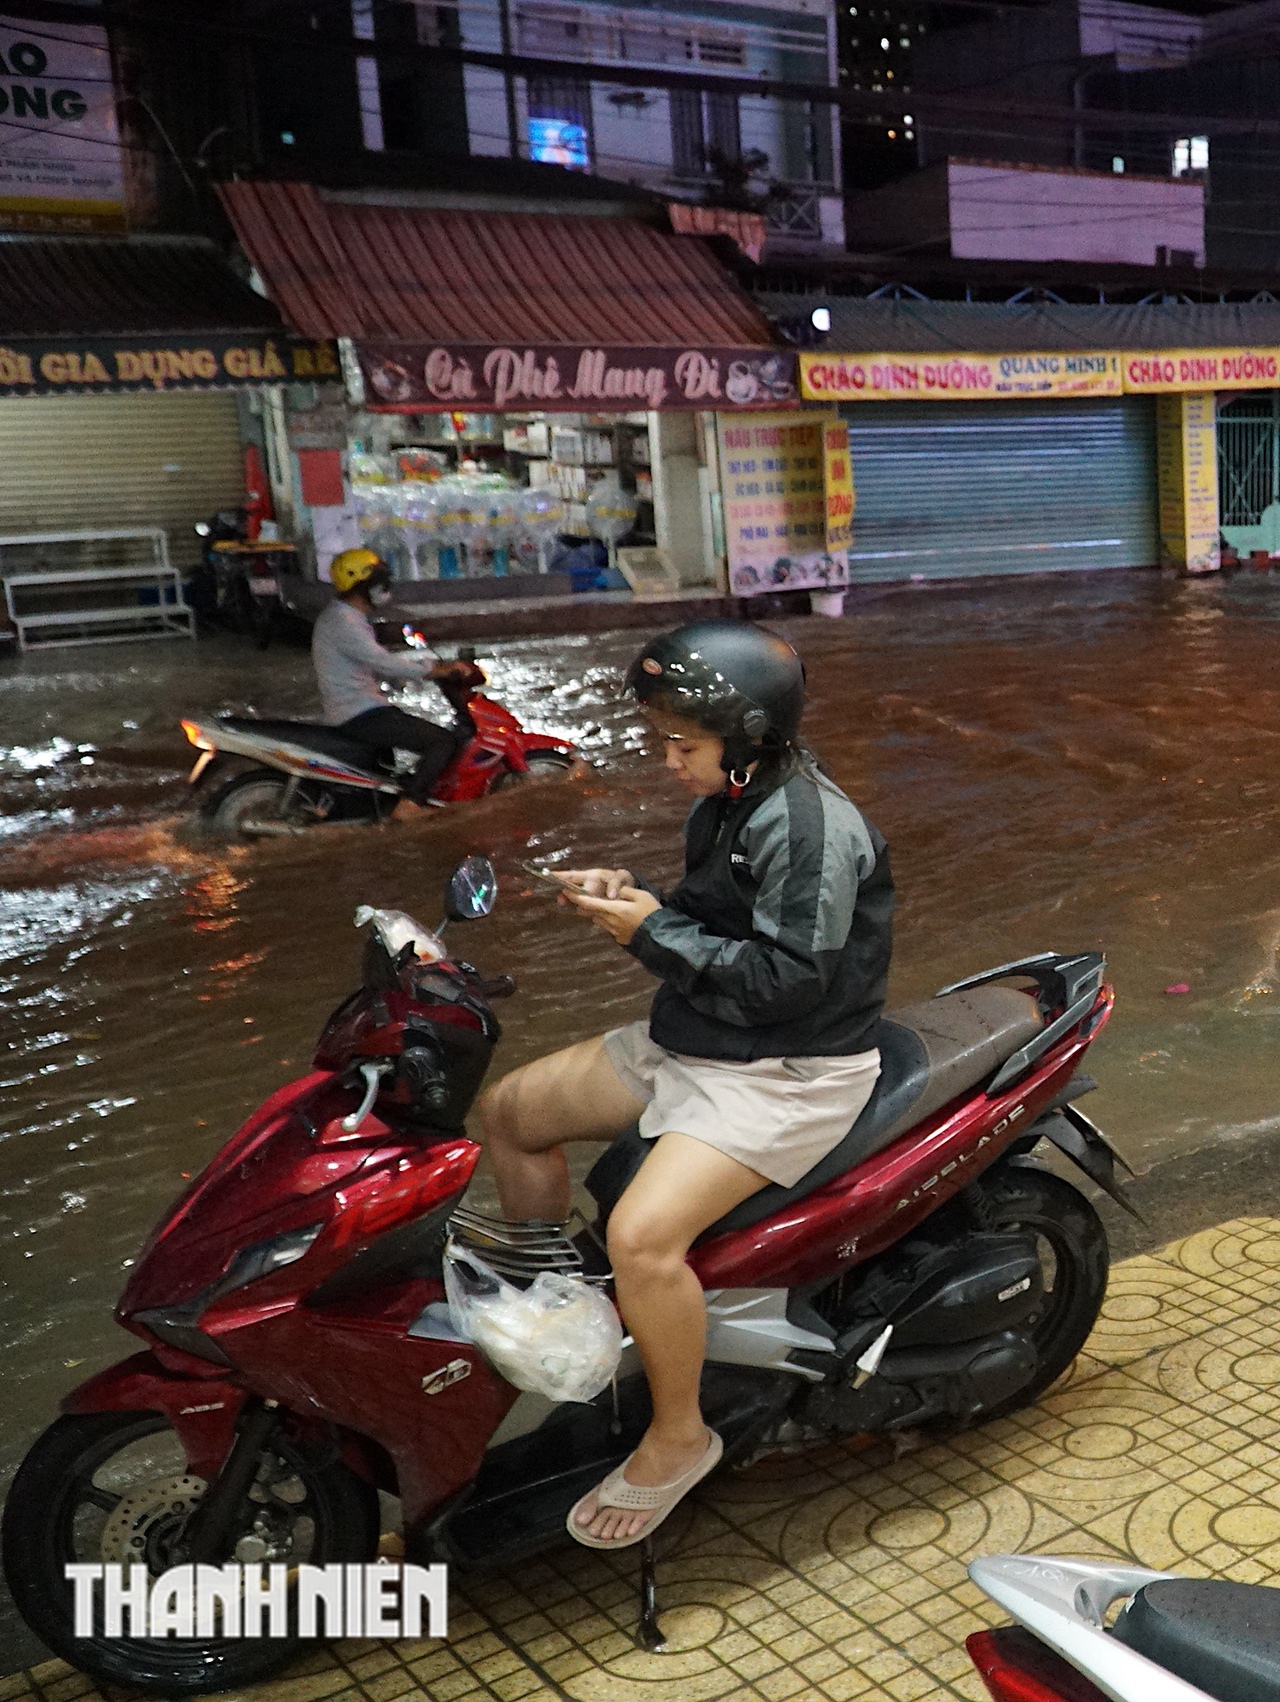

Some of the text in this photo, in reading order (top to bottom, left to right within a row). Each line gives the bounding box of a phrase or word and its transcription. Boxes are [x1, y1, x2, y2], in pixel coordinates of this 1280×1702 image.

[0, 42, 47, 76] O
[0, 85, 88, 121] NG
[40, 353, 111, 383] GIA
[115, 349, 218, 388] DỤNG
[223, 340, 287, 377] GIÁ
[567, 349, 667, 407] Mang
[674, 350, 721, 400] Đi
[808, 358, 992, 390] CHÁO DINH DƯỠNG
[1000, 356, 1059, 378] QUANG
[1065, 356, 1106, 373] MINH
[1128, 351, 1277, 383] CHÁO DINH DƯỠNG
